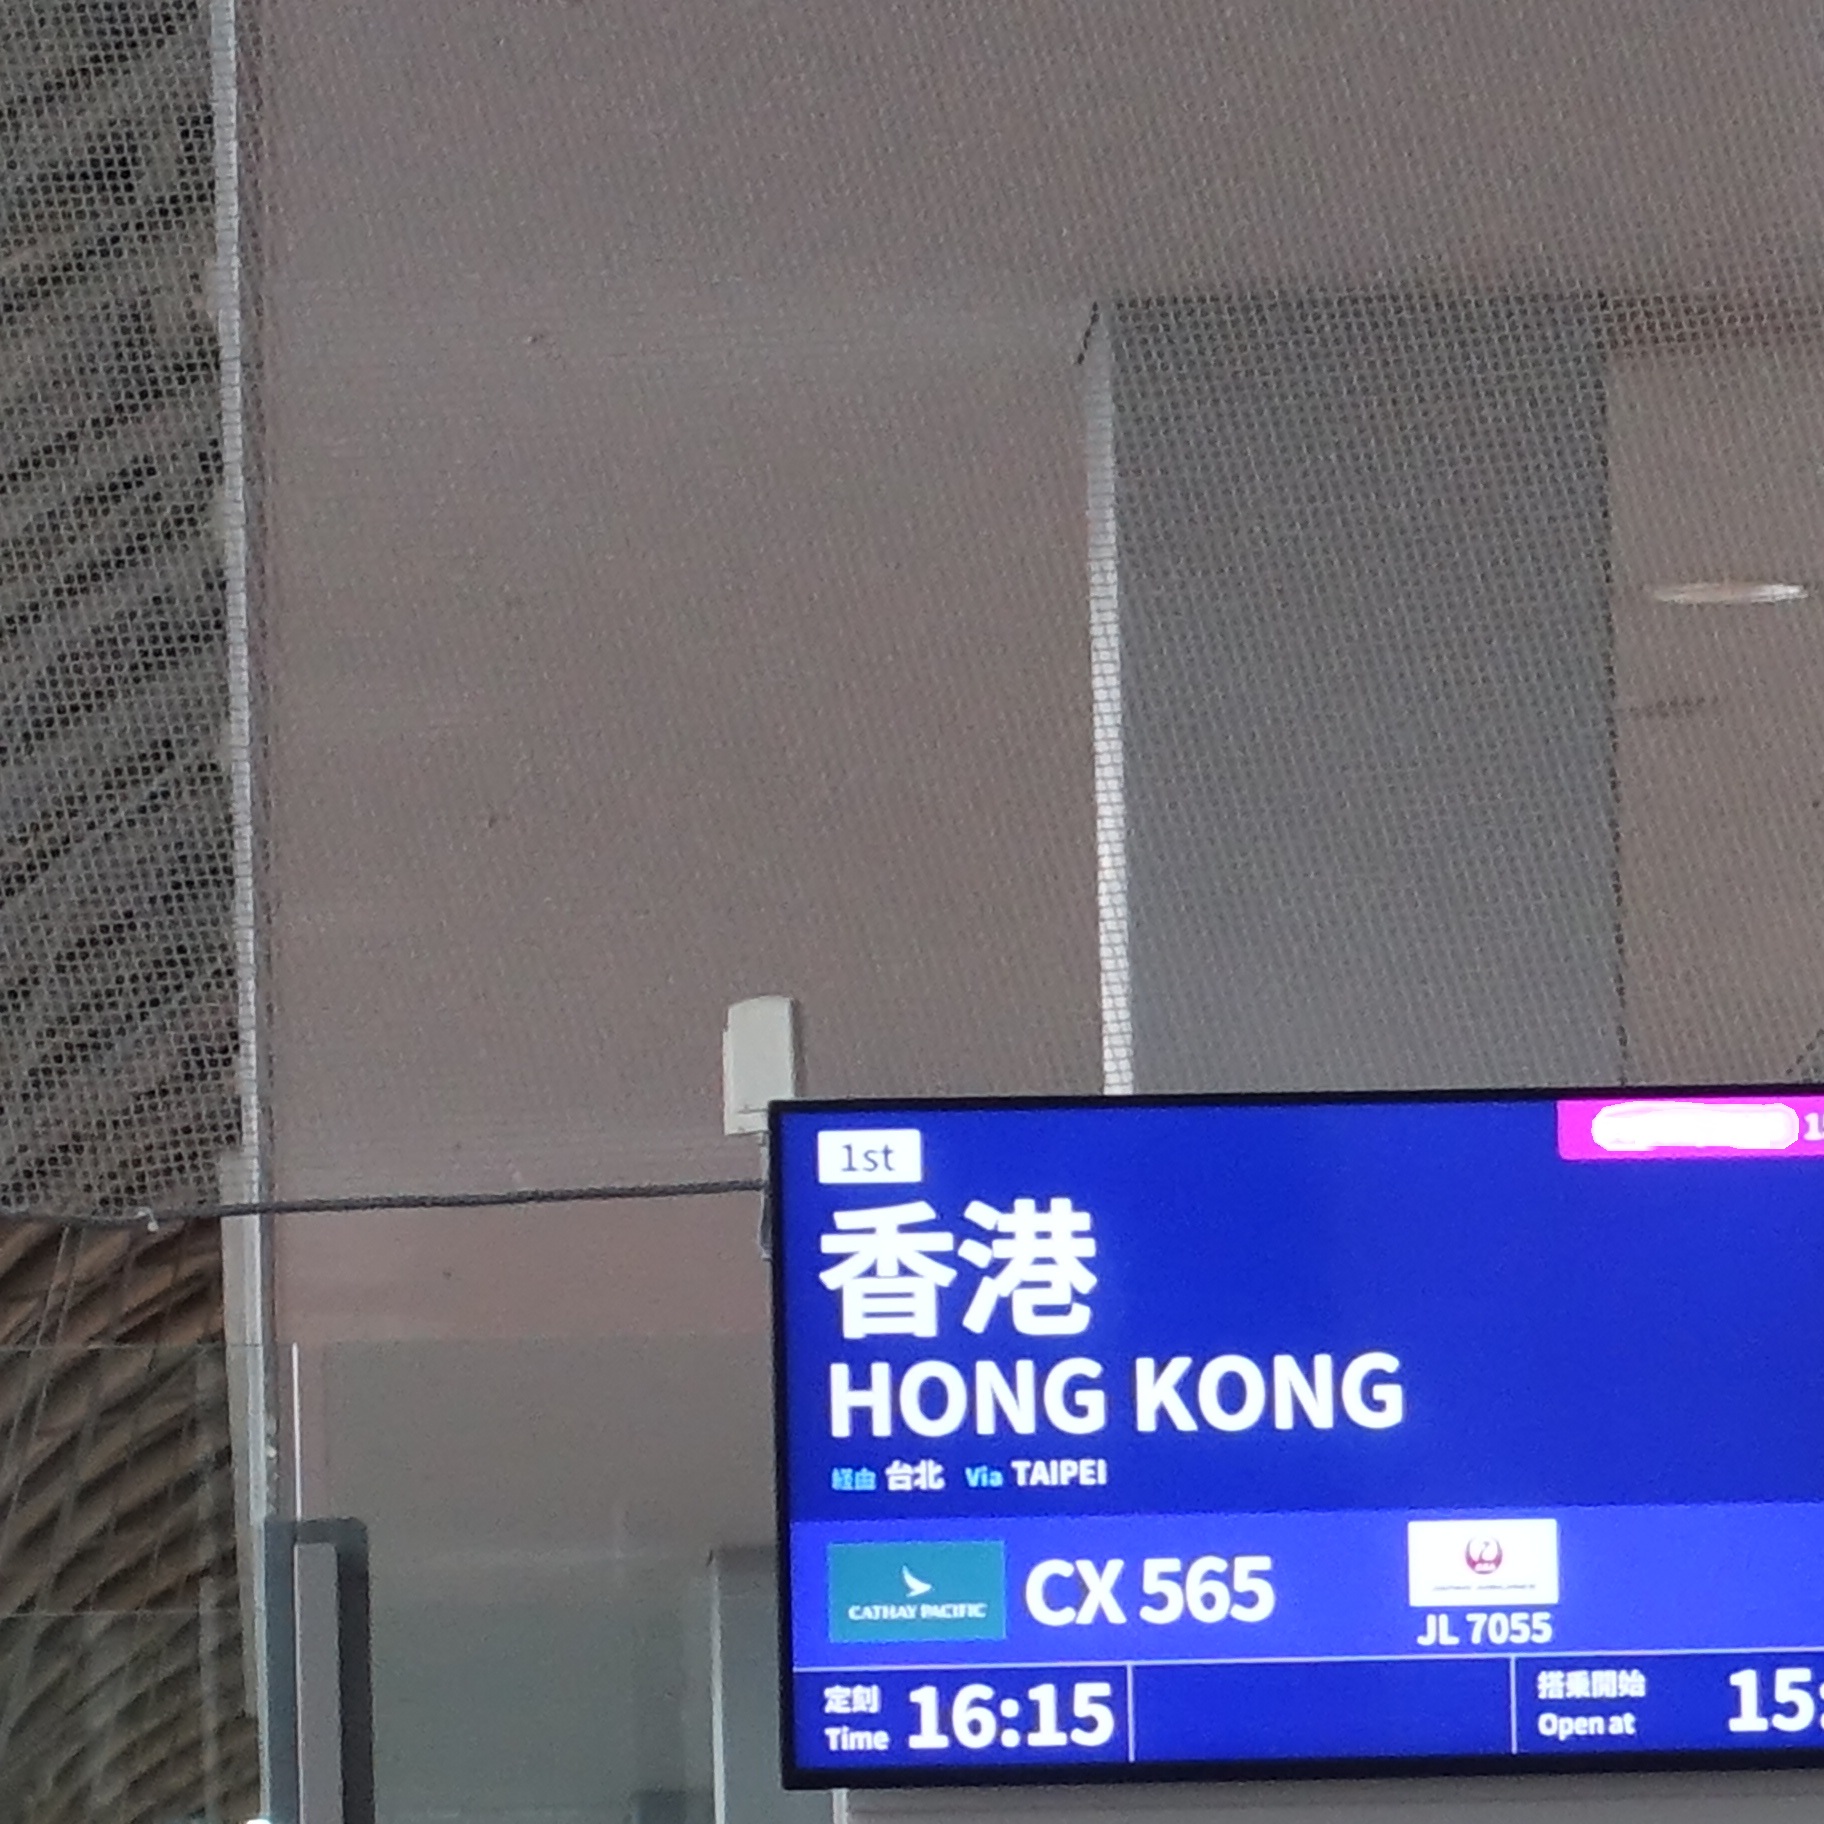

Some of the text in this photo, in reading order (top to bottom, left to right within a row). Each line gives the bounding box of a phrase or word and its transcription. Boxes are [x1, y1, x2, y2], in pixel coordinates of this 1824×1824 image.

[840, 1143, 896, 1172] 1st
[818, 1196, 1098, 1340] 香港
[829, 1351, 1405, 1439] HONG KONG
[884, 1459, 946, 1491] 台北
[964, 1458, 1108, 1488] Via TAIPEI
[1025, 1554, 1277, 1628] CX 565
[848, 1602, 988, 1621] CATHAY PACIFIC
[1417, 1611, 1553, 1646] JL 7055
[823, 1684, 881, 1714] 定刻
[908, 1682, 1116, 1750] 16:15
[1537, 1711, 1637, 1740] Open at
[824, 1725, 889, 1751] Time
